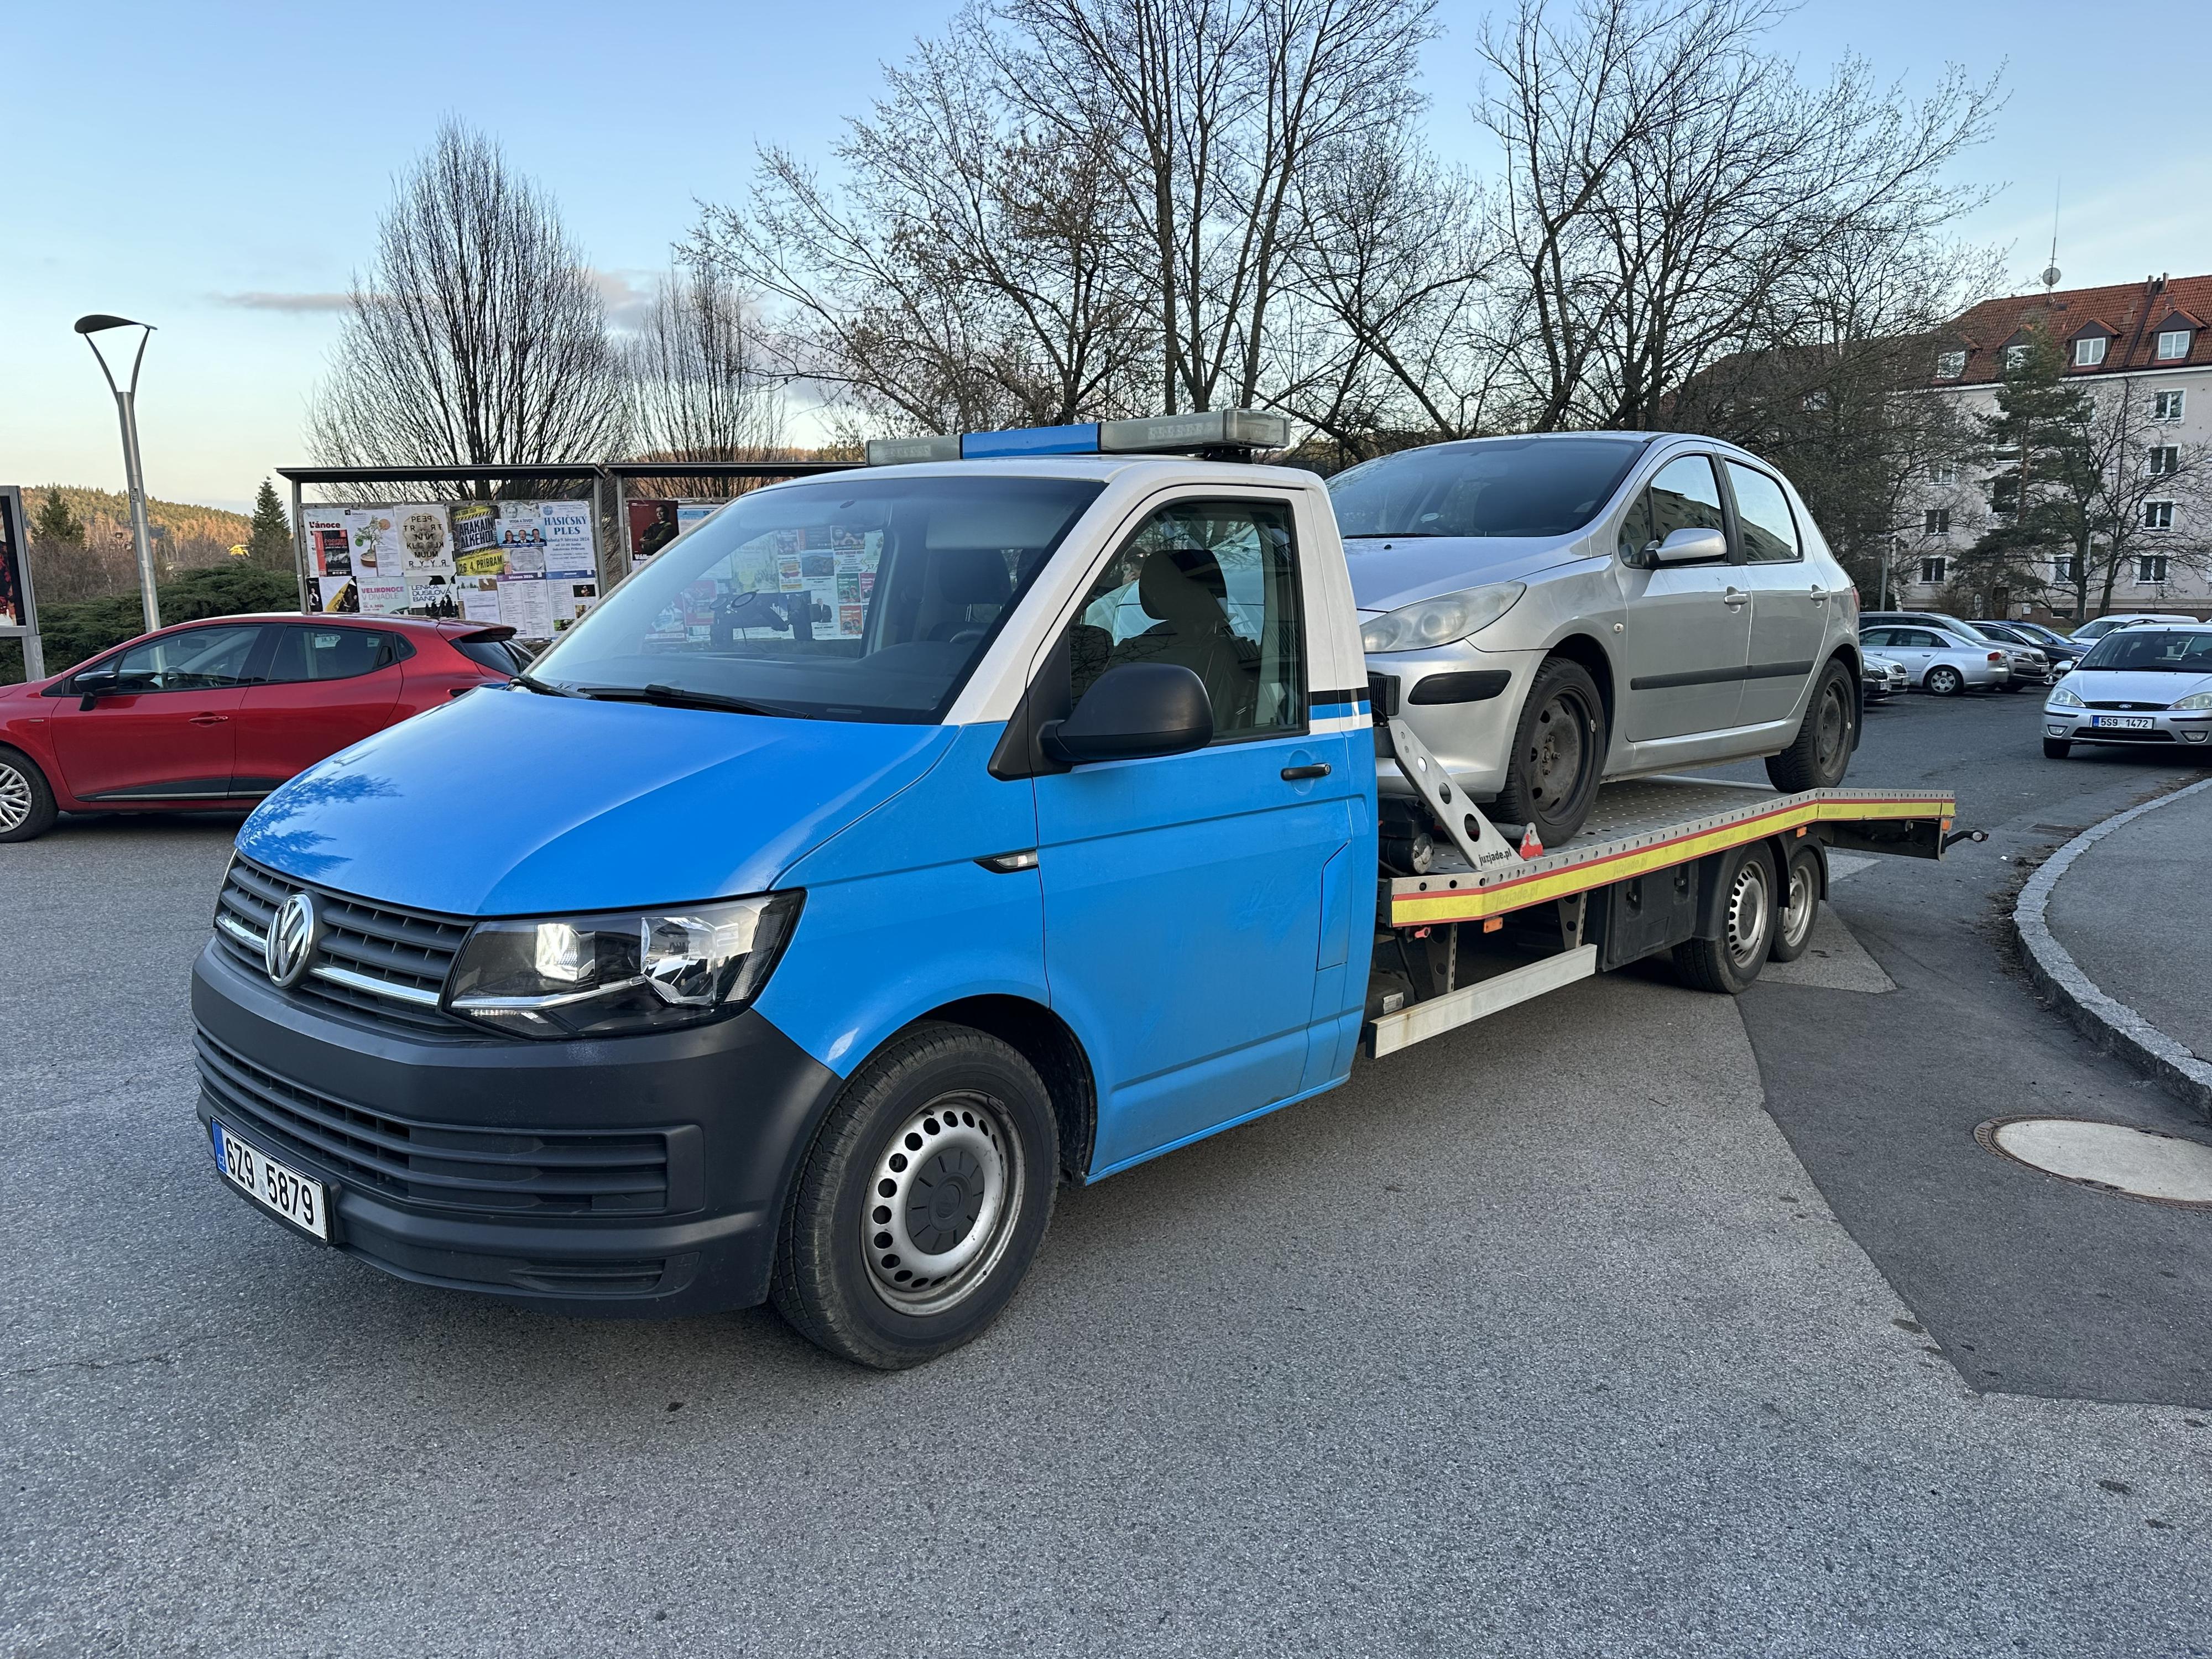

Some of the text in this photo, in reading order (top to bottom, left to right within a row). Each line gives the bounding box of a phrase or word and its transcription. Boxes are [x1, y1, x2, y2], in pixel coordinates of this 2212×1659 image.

[460, 517, 493, 536] ARAKAIN
[545, 514, 587, 525] HASIČSKÝ
[461, 530, 494, 547] ALKEHOL
[554, 526, 580, 535] PLES
[2101, 718, 2148, 728] 5S9 1472
[1478, 848, 1512, 866] juzjade.pl
[226, 1137, 314, 1225] 6Z9 5879
